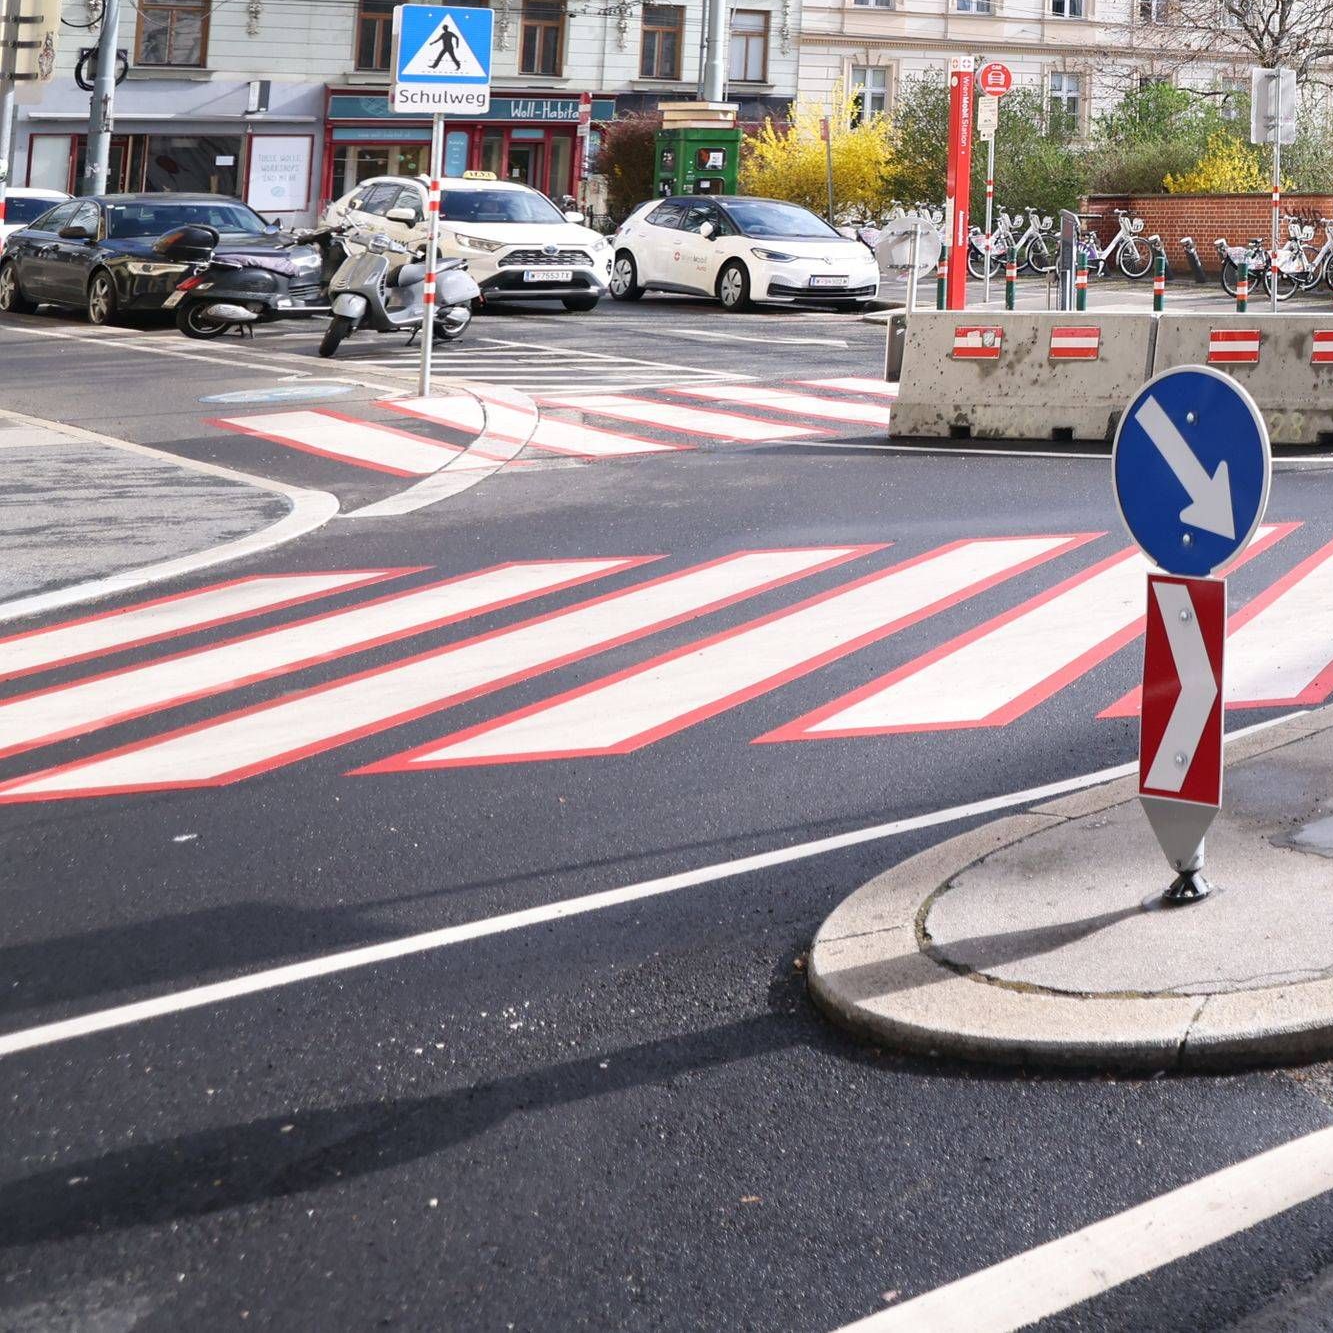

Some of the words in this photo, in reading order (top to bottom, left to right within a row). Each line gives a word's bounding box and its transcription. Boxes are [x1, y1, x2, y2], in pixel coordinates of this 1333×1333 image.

[399, 89, 486, 107] Schulweg
[510, 100, 580, 119] Woll-Habita
[960, 119, 969, 147] Station
